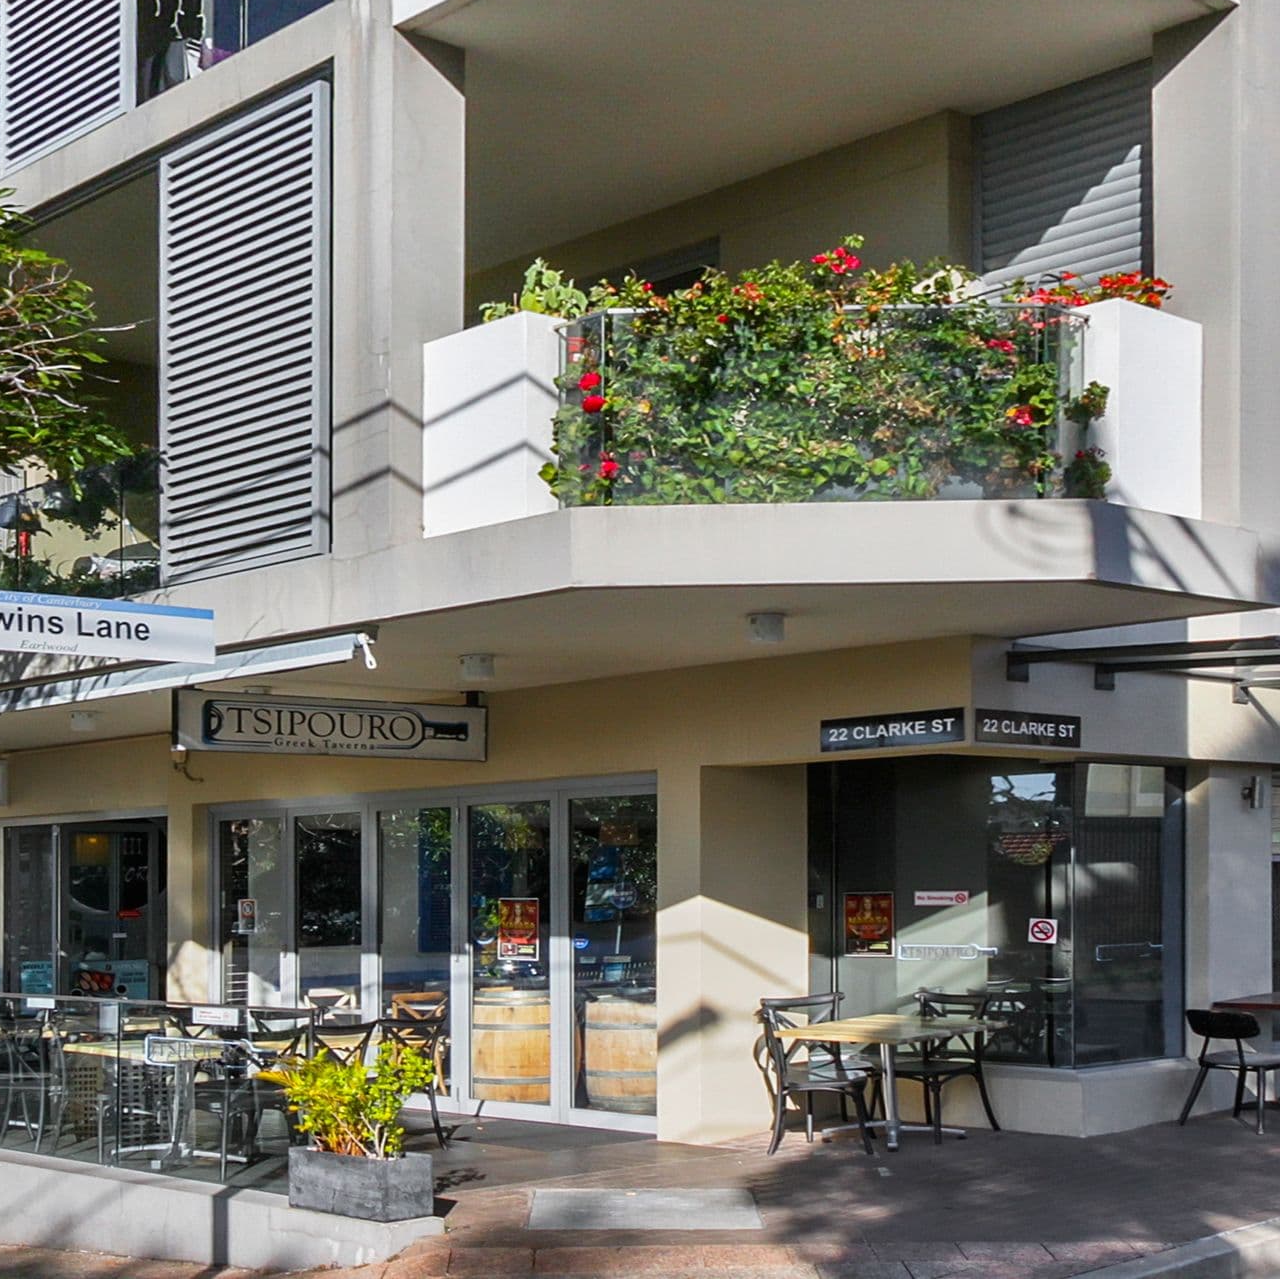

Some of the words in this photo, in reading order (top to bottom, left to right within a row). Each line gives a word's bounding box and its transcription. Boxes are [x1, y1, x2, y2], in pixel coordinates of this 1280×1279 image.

[22, 593, 35, 604] of
[38, 594, 103, 609] Canterbury
[76, 611, 151, 641] Lane
[19, 639, 79, 652] Earlwood
[226, 707, 417, 741] TSIPOURO
[829, 729, 848, 742] 22
[853, 719, 927, 740] CLARKE
[931, 718, 955, 733] ST
[983, 719, 998, 733] 22
[1001, 720, 1055, 737] CLARKE
[1058, 724, 1075, 738] ST
[274, 737, 316, 748] Greek
[322, 738, 376, 750] Taverna
